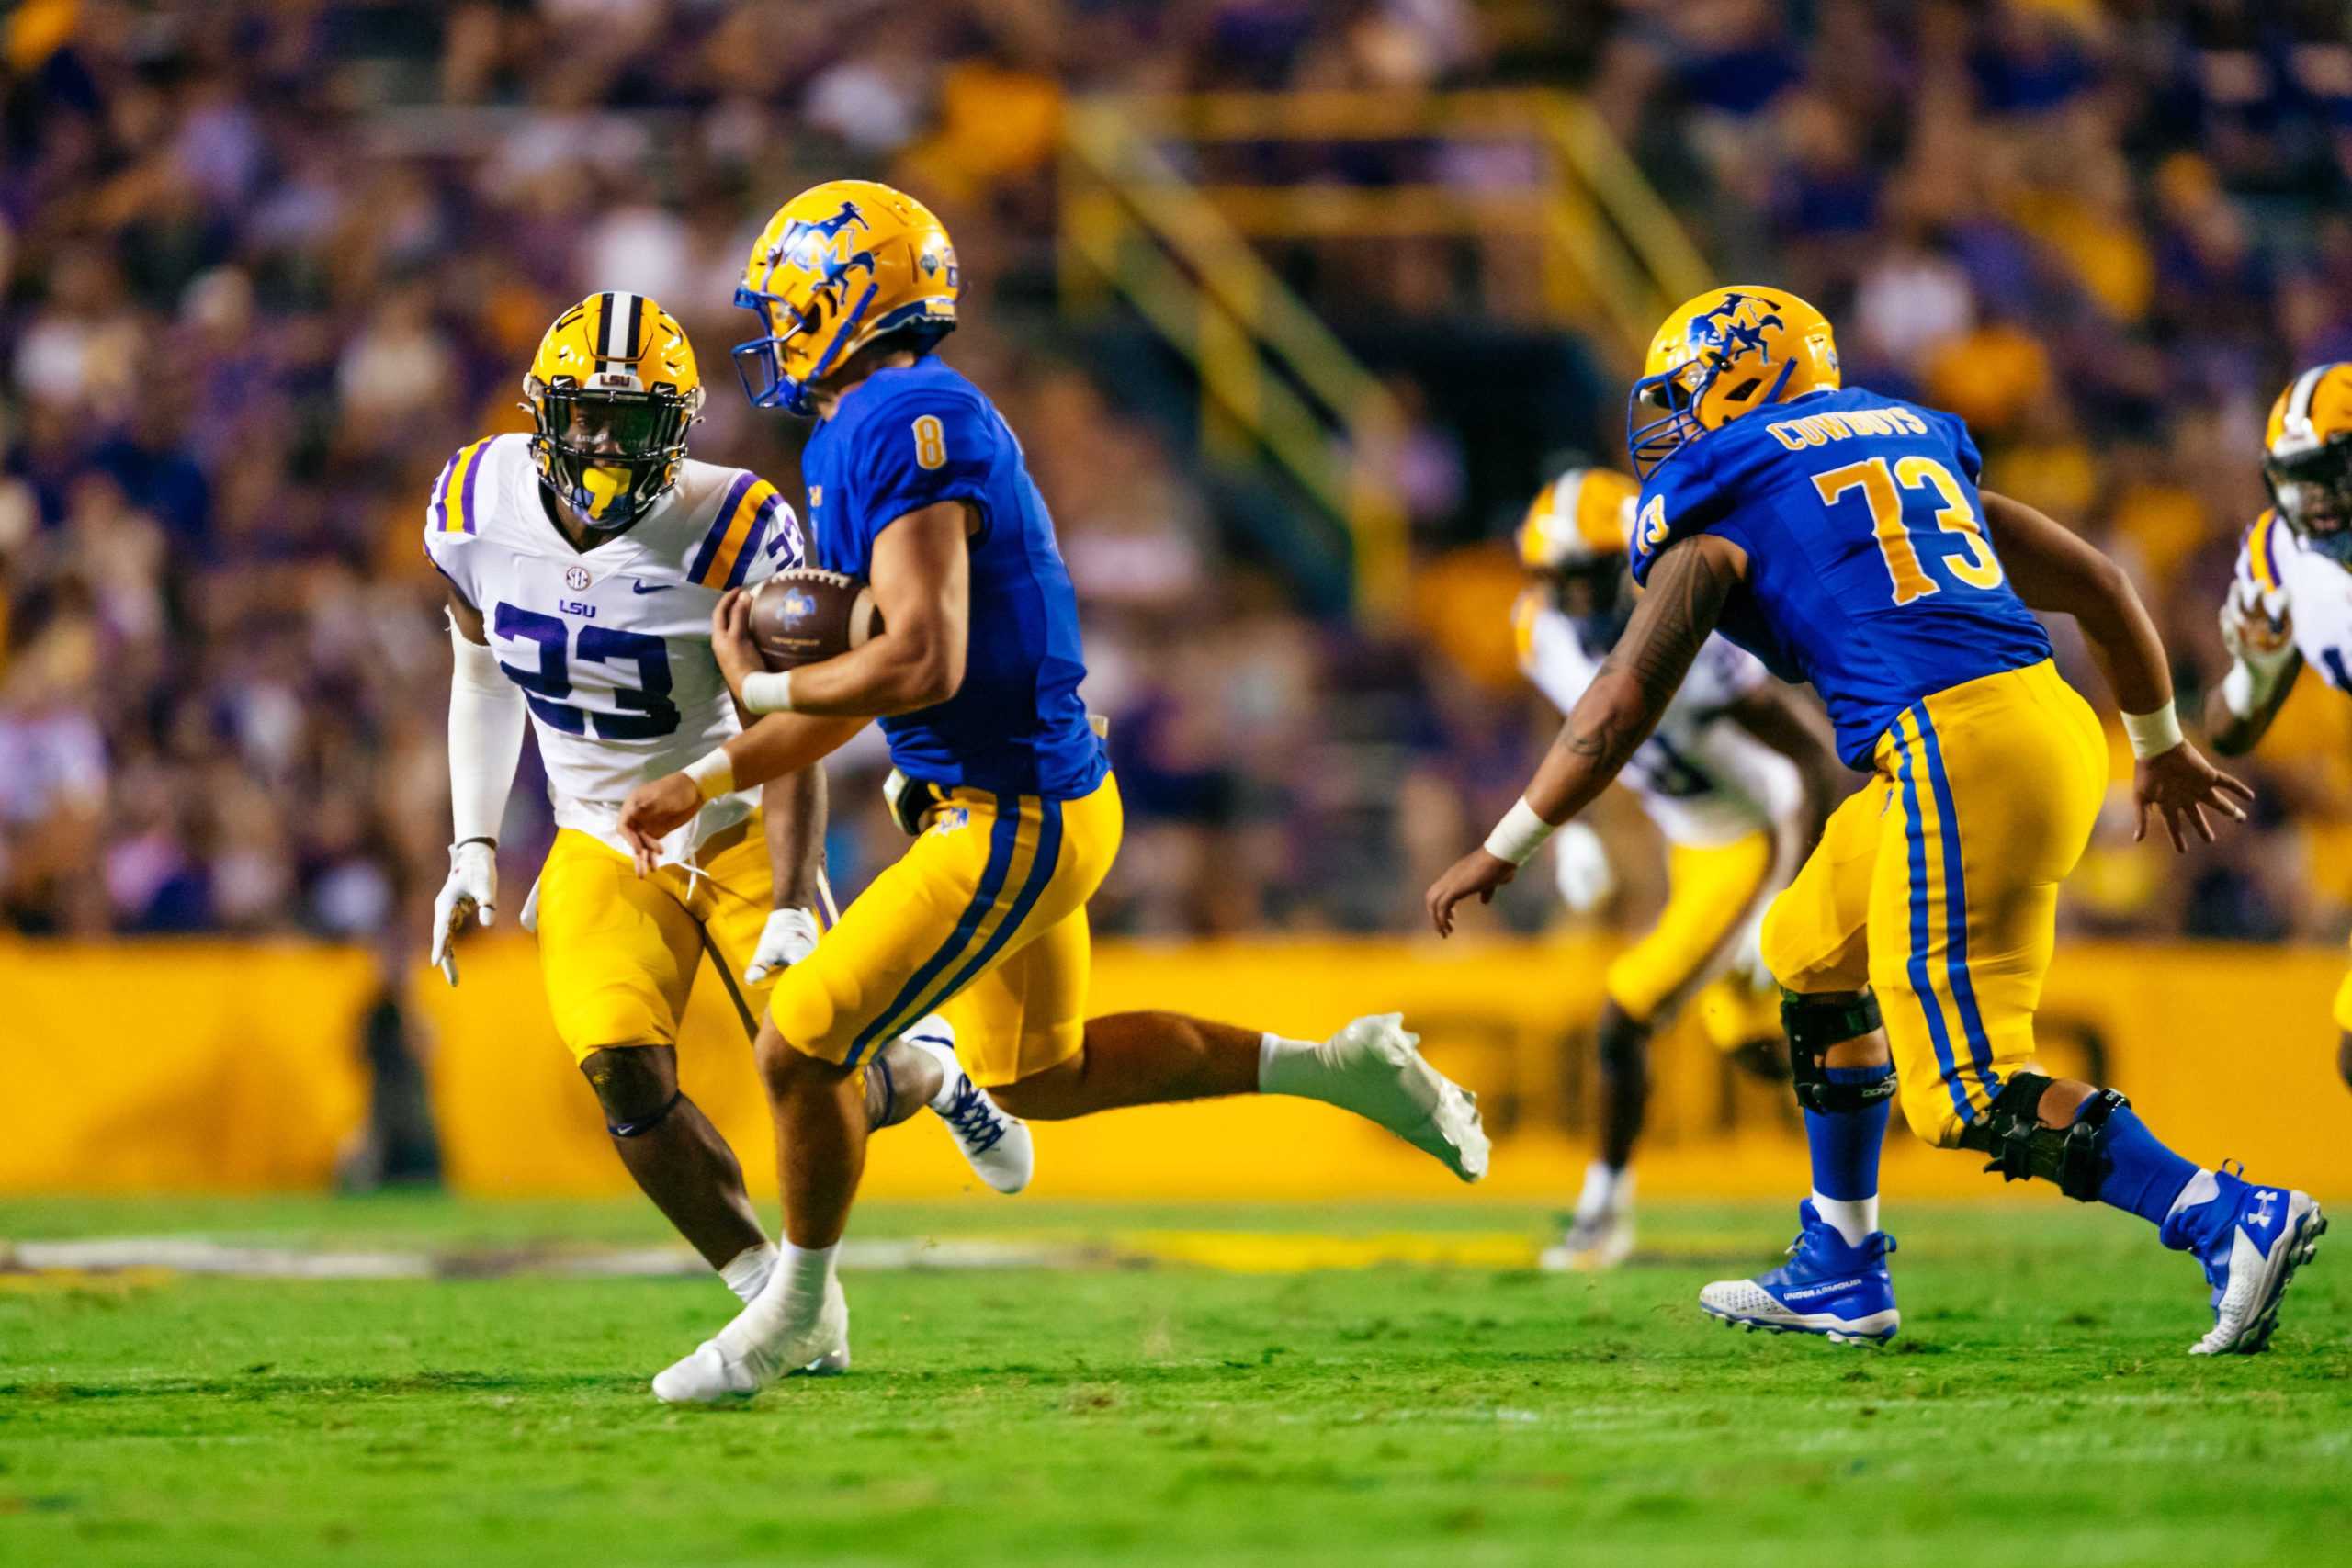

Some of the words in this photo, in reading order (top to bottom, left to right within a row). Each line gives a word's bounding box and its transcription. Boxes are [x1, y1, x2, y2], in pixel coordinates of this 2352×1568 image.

[600, 375, 630, 387] LSU
[911, 414, 947, 470] 8
[1766, 407, 1927, 450] COWBOYS
[1810, 456, 2003, 606] 73
[560, 599, 596, 618] LSU
[494, 601, 681, 739] 23
[1783, 1289, 1815, 1301] UNDER
[1815, 1278, 1862, 1295] ARMOUR
